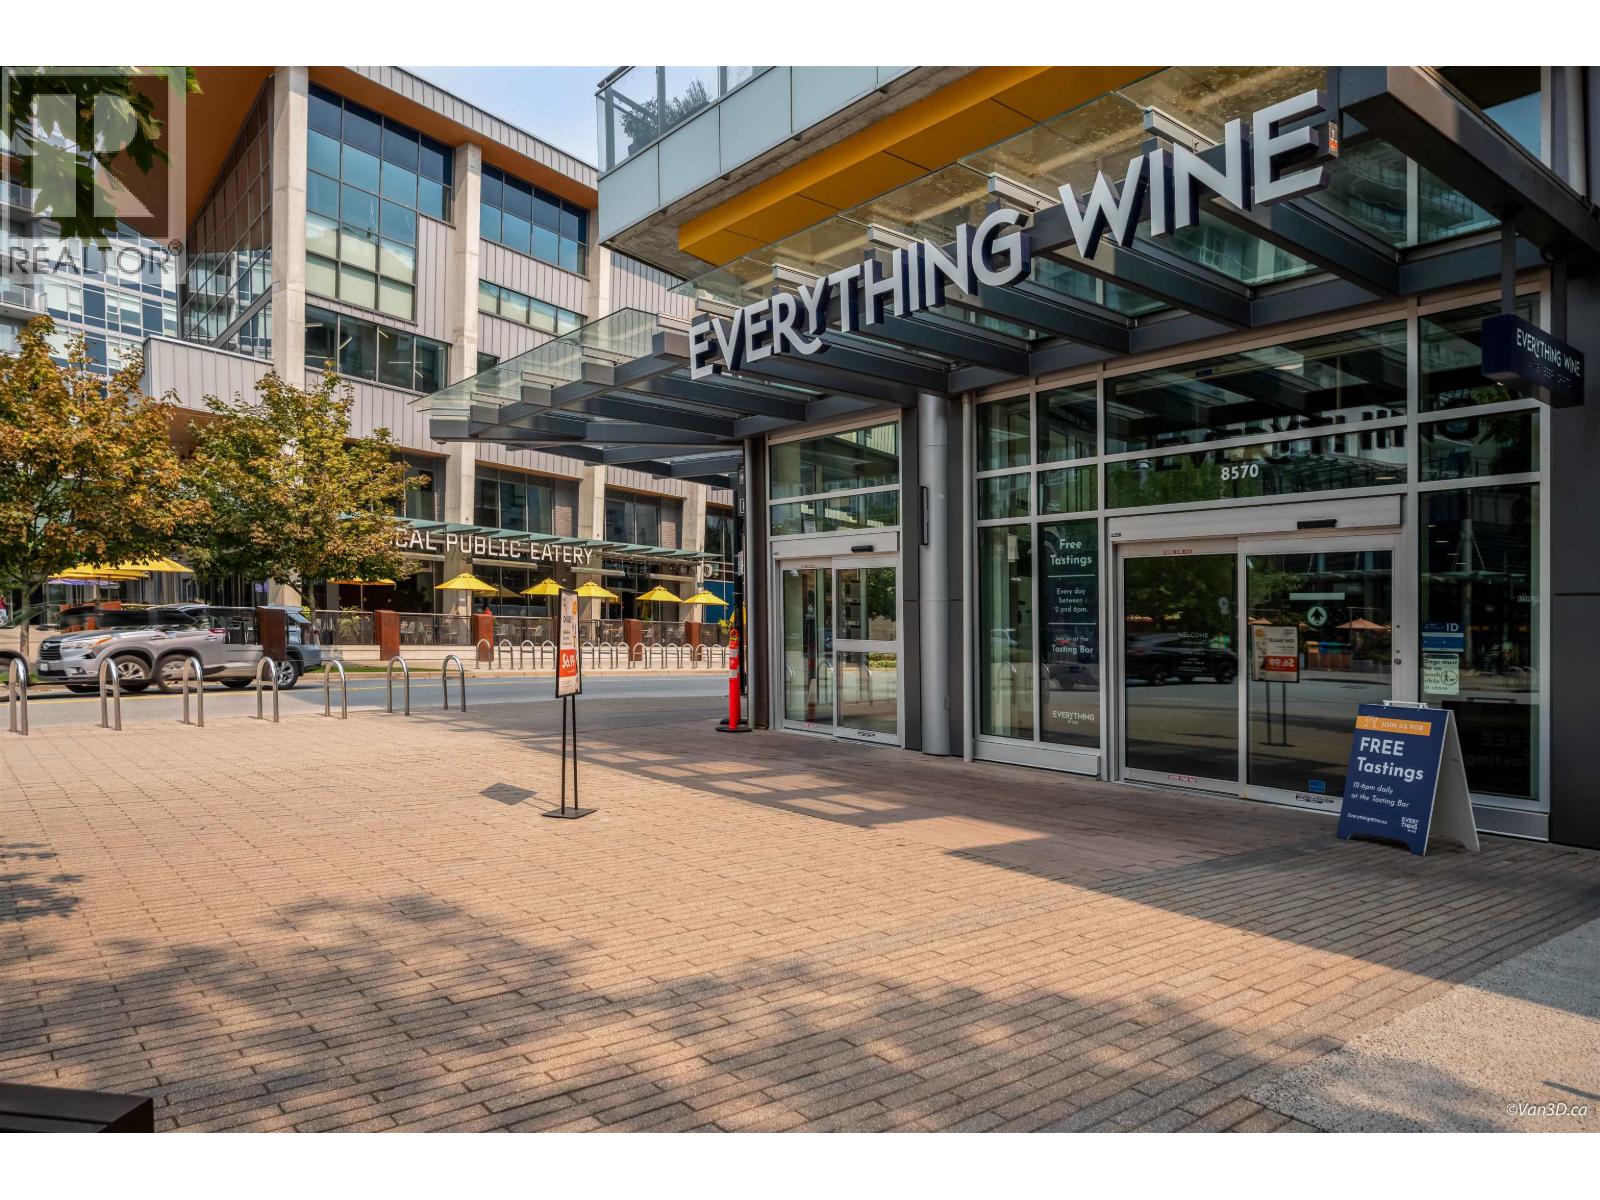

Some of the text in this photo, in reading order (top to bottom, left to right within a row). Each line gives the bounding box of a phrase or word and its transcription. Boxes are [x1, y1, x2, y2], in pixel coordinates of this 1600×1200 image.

[689, 88, 1330, 380] EVERYTHING WINE
[1516, 327, 1562, 367] EVERYTHING
[1564, 353, 1581, 377] WINE
[1220, 463, 1260, 481] 8570
[385, 528, 593, 565] CAL PUBLIC EATERY
[1059, 538, 1082, 550] Free
[1050, 554, 1093, 567] Tastings
[1056, 587, 1086, 596] Every day
[1446, 622, 1459, 632] ID
[1177, 631, 1209, 639] WELCOME
[1051, 645, 1093, 655] Tasting Bar
[1052, 710, 1095, 721] EVERYTHING
[1381, 721, 1425, 731] JOIN US FOR
[1359, 736, 1405, 757] FREE
[1357, 756, 1424, 783] Tastings
[1352, 781, 1394, 795] 12-6pm daily
[1359, 793, 1370, 801] the
[1372, 794, 1396, 807] Tasting
[1397, 800, 1410, 808] Bar
[1401, 816, 1420, 824] EVERY
[1401, 822, 1418, 831] THING
